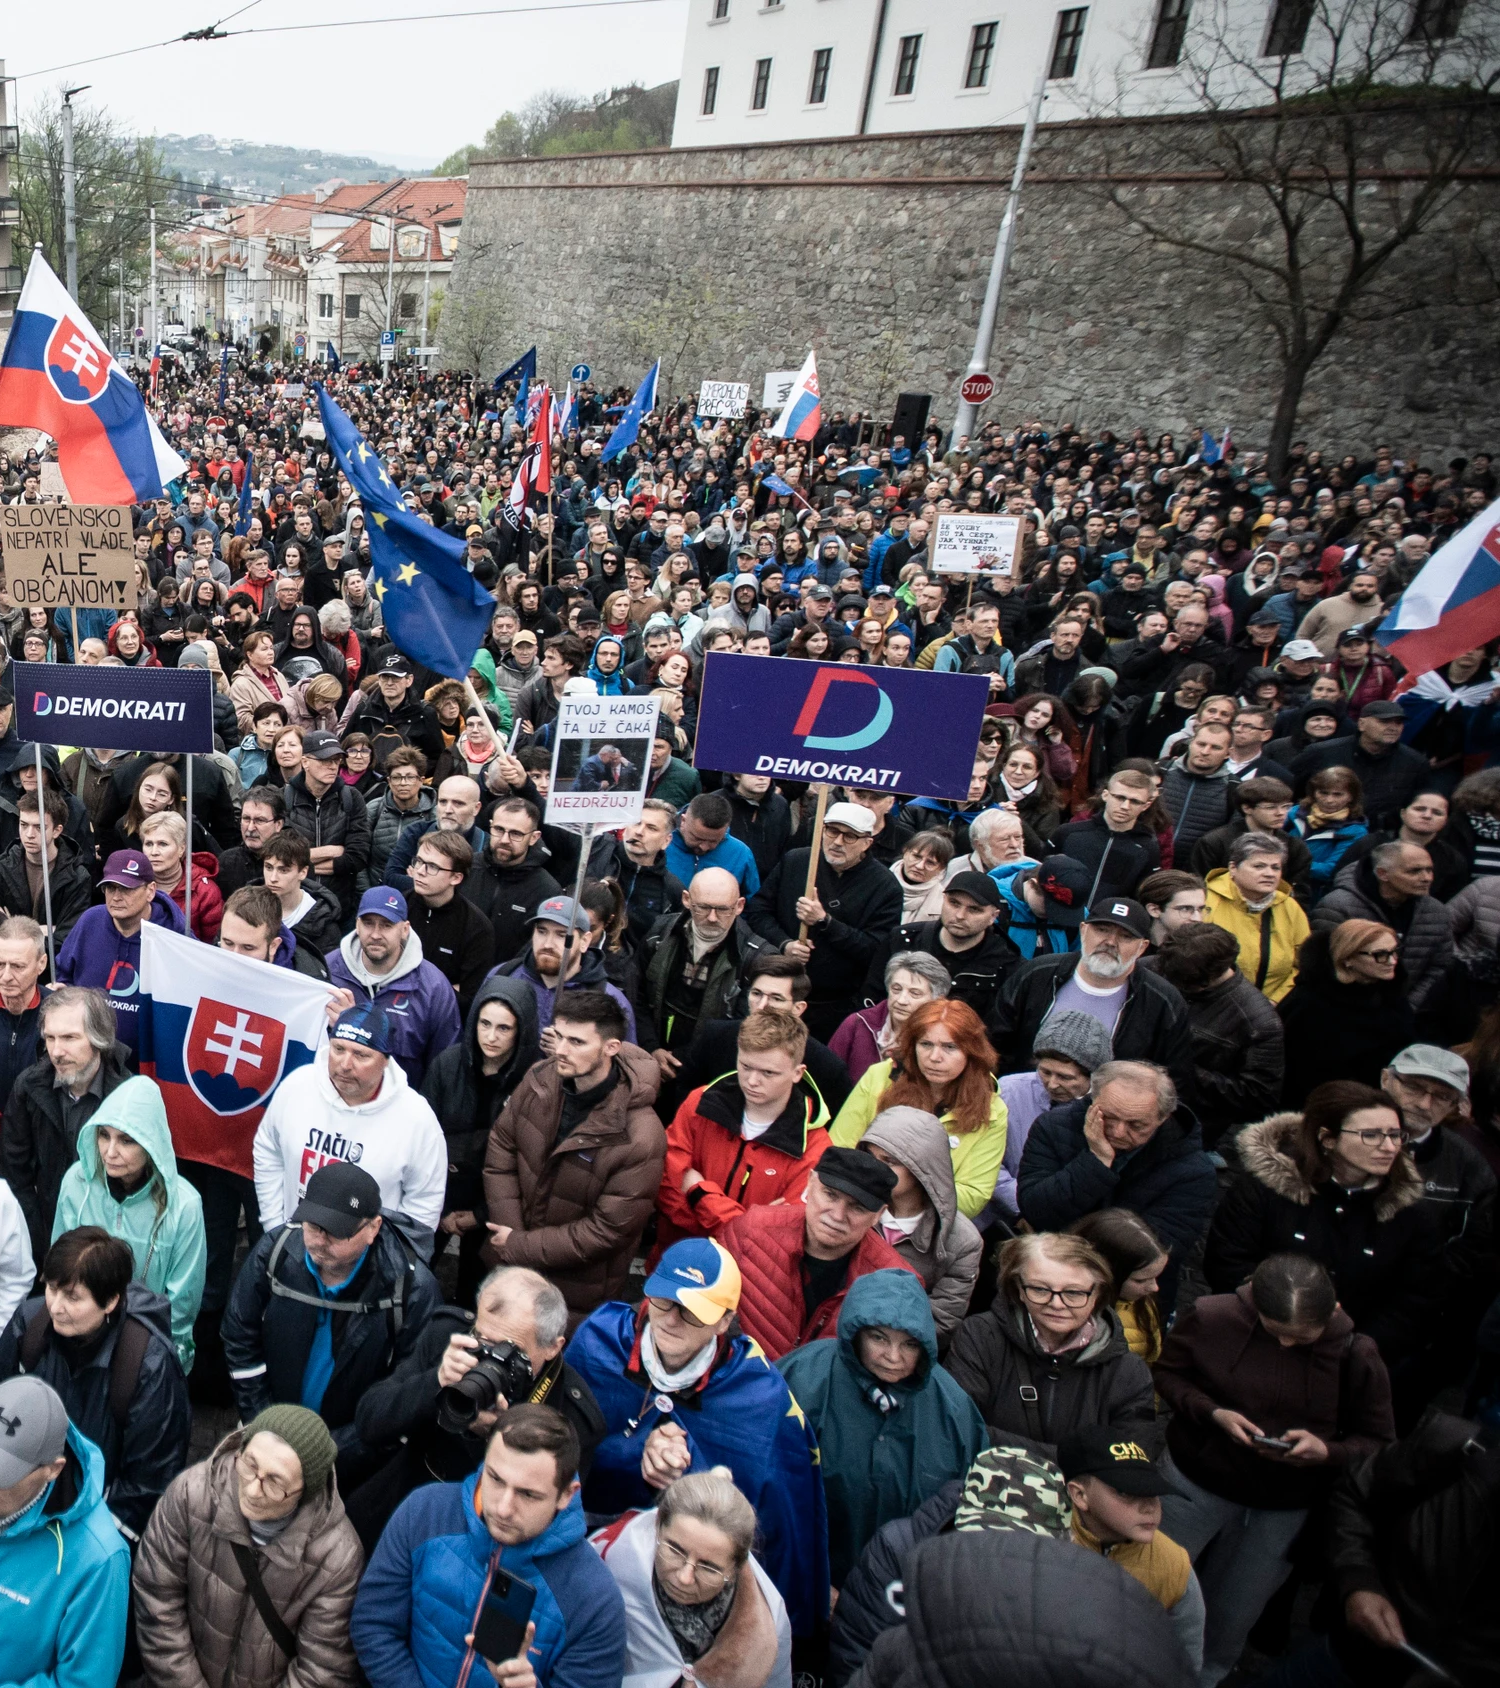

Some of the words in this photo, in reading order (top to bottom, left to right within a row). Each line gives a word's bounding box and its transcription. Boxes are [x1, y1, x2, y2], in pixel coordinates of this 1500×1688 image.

[963, 382, 992, 395] STOP
[4, 508, 121, 528] SLOVENSKO
[7, 528, 69, 549] NEPATRÍ
[80, 529, 132, 551] VLÁDE,
[41, 553, 97, 576] ALE
[13, 576, 127, 604] OBČANOM!
[54, 696, 187, 722] DEMOKRATI
[565, 704, 601, 716] TVOJ
[609, 701, 654, 715] KAMOŠ
[563, 720, 580, 734] ŤA
[589, 720, 607, 733] UŽ
[615, 719, 651, 733] ČAKÁ
[755, 755, 901, 787] DEMOKRATI
[553, 794, 635, 808] NEZDRŽUJ!
[105, 1000, 140, 1013] MOKRAT
